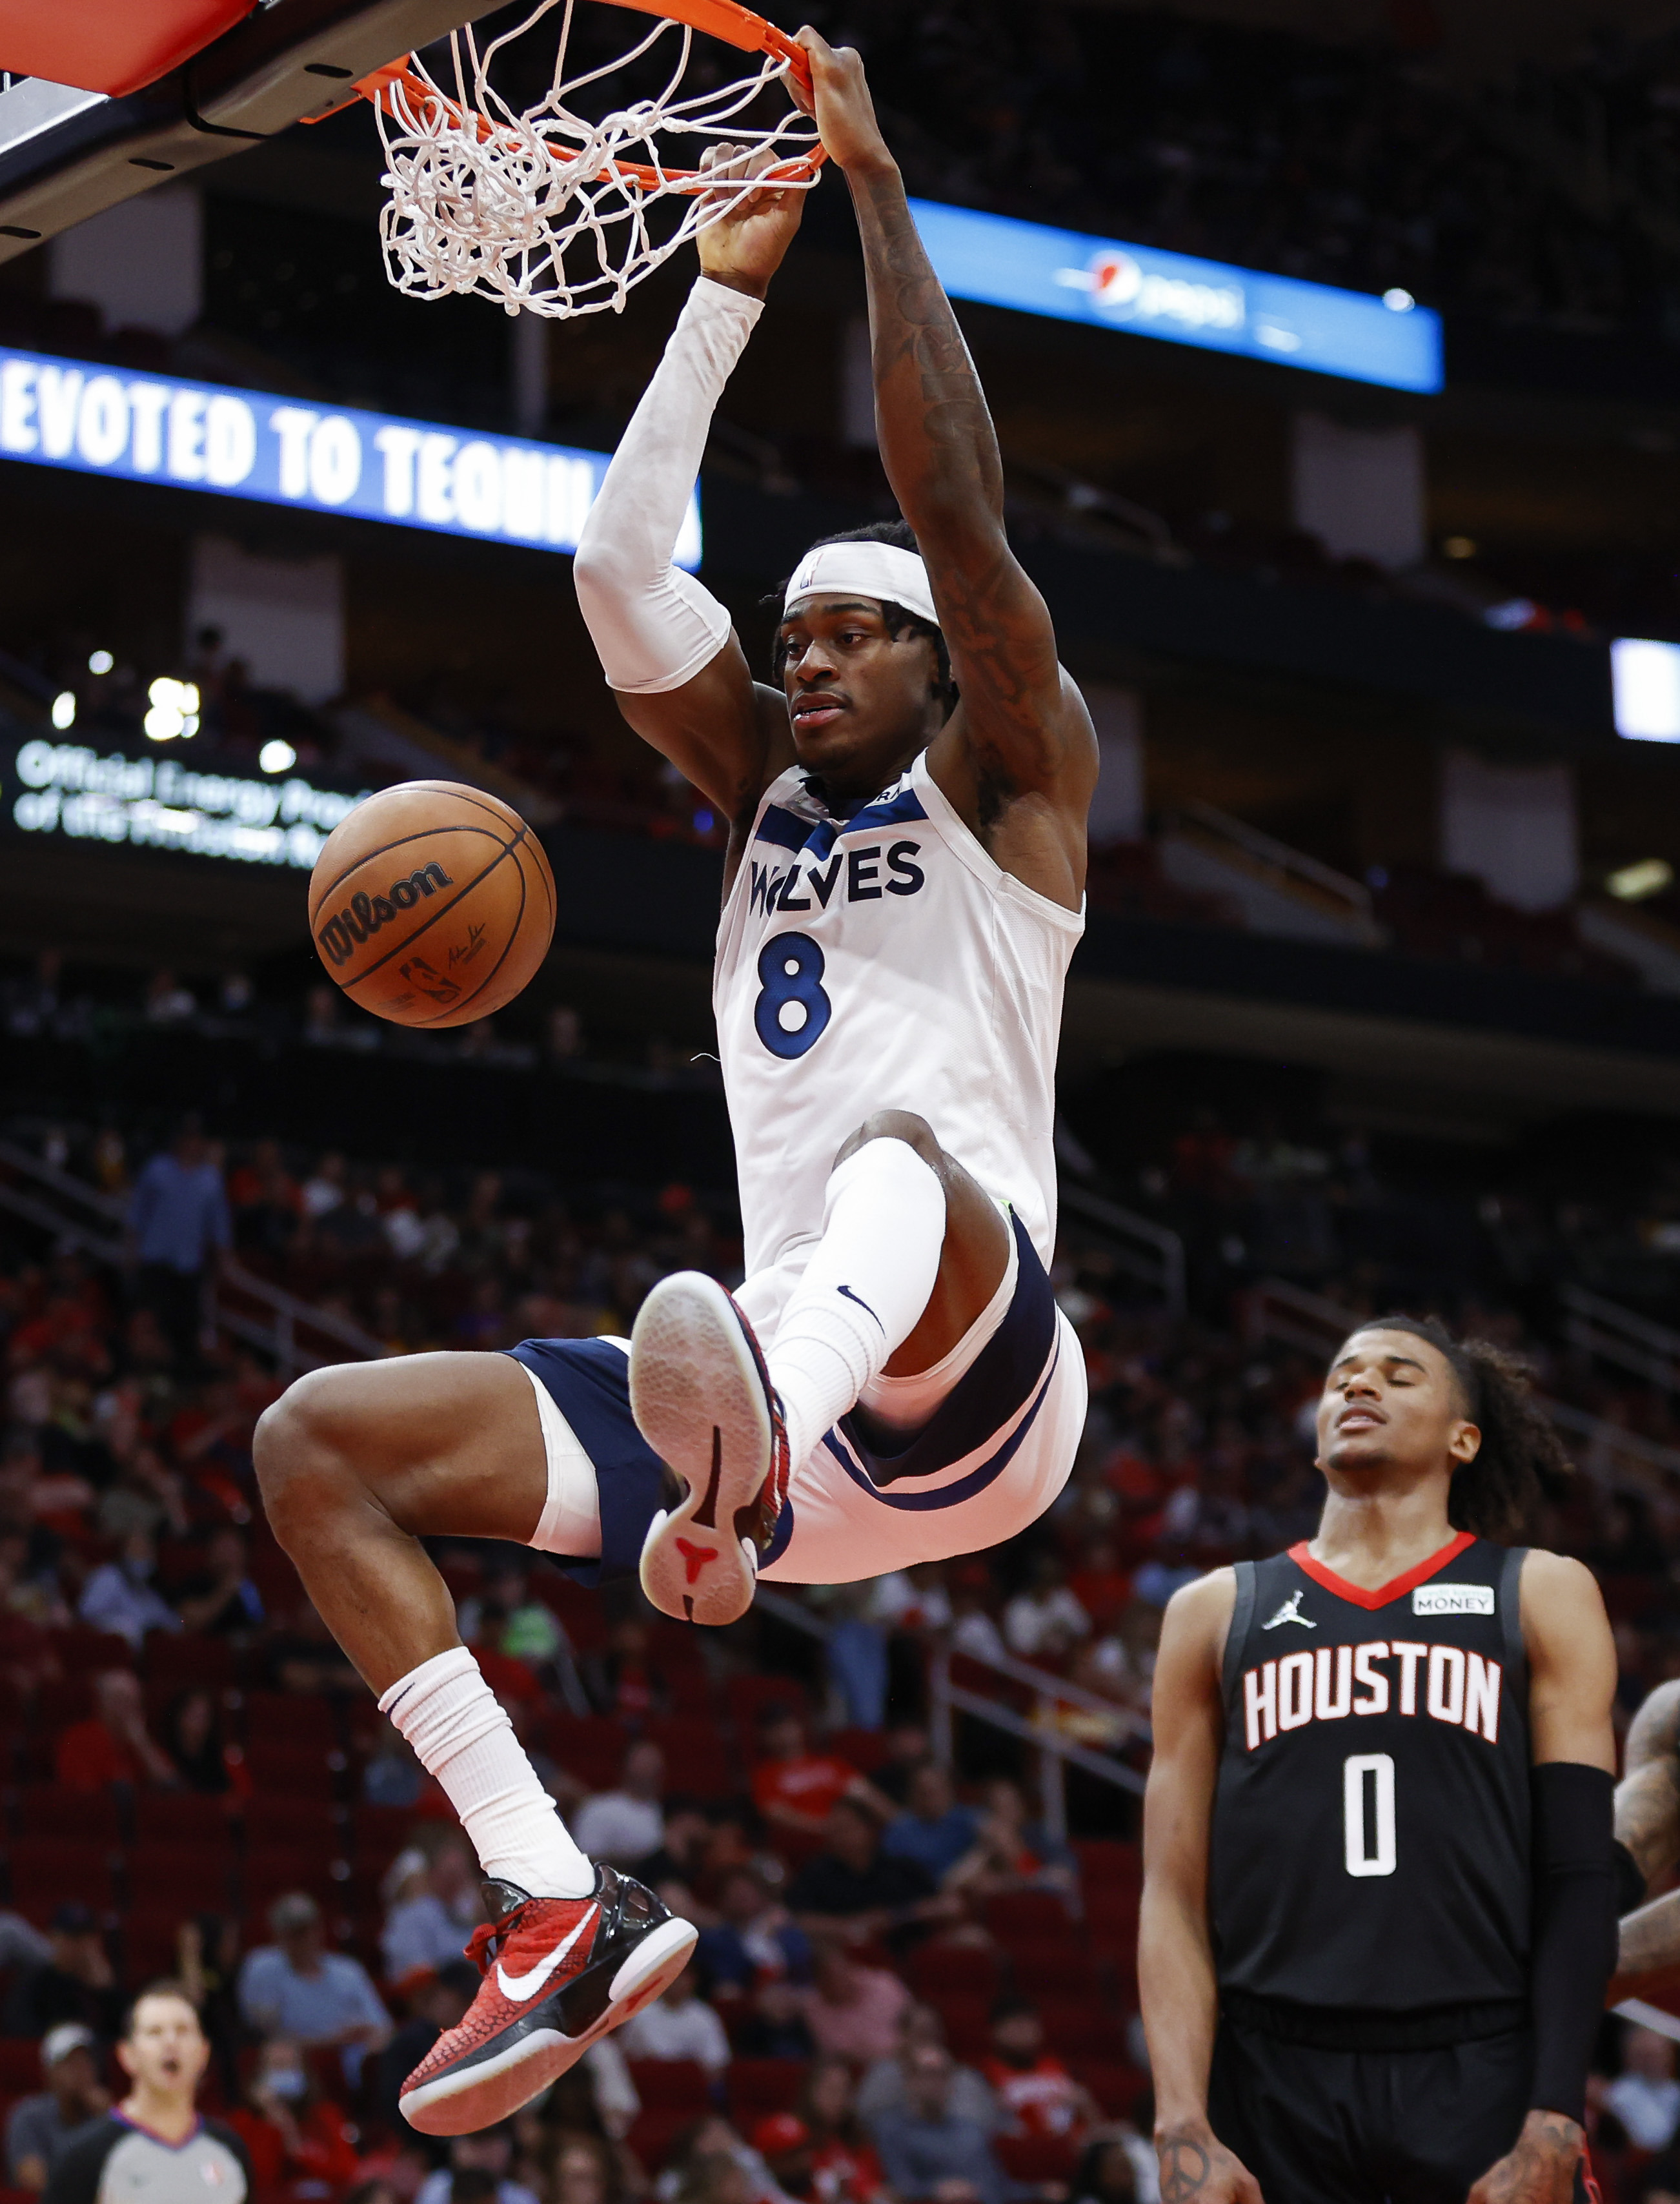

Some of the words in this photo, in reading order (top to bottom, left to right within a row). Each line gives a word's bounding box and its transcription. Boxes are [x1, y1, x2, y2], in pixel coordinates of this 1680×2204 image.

[1, 358, 256, 487] EVOTED
[269, 406, 361, 506] TO
[319, 861, 454, 967] Wilson
[754, 930, 832, 1060] 8
[1417, 1597, 1488, 1612] MONEY
[1243, 1640, 1503, 1751] HOUSTON
[1343, 1751, 1397, 1878] 0
